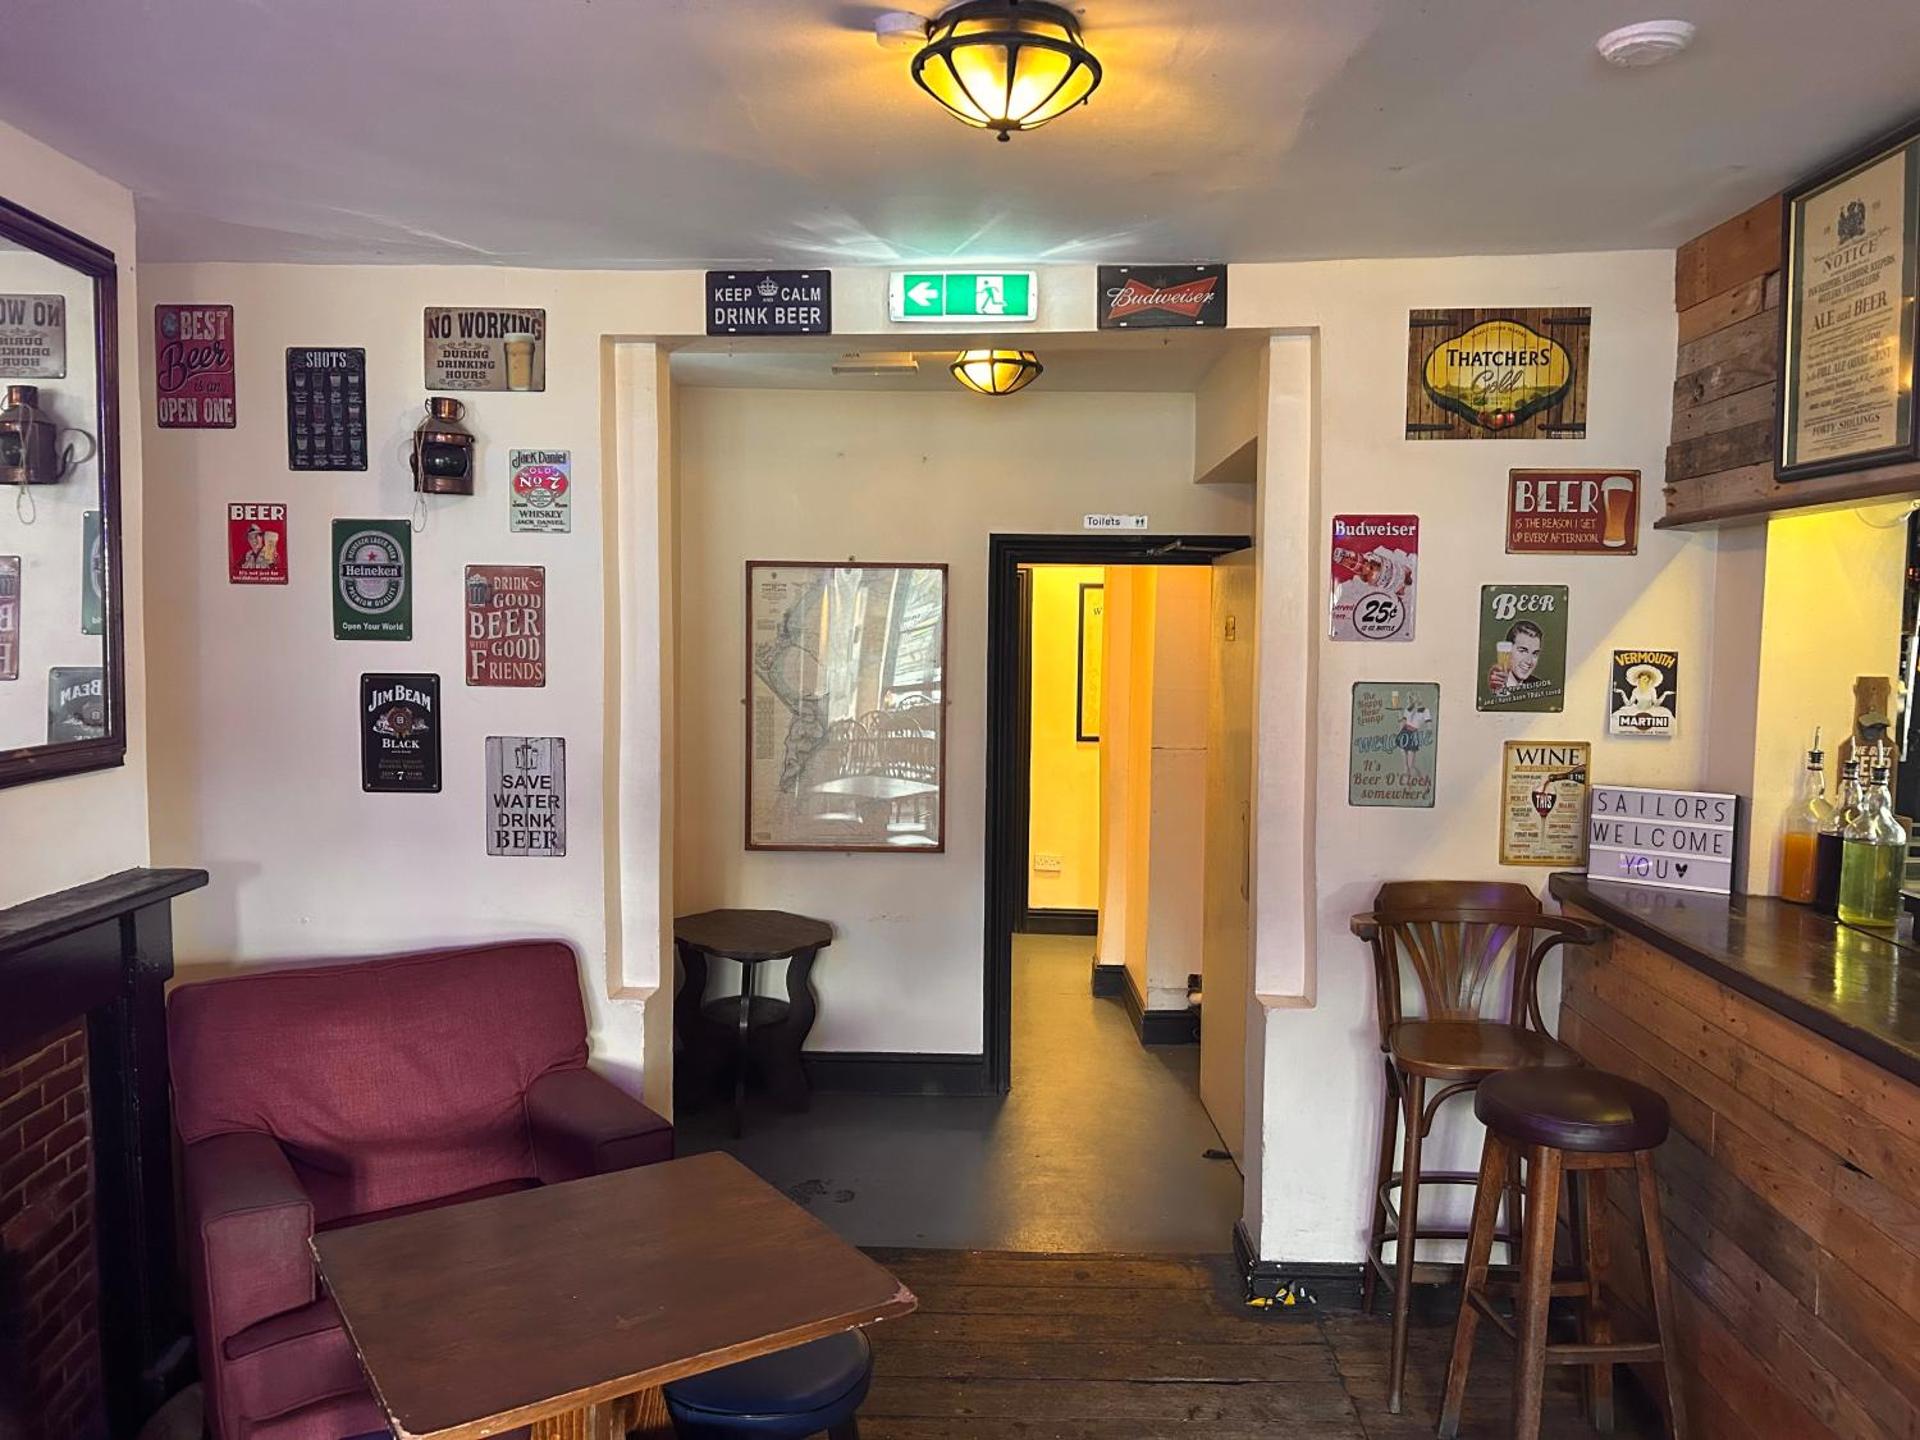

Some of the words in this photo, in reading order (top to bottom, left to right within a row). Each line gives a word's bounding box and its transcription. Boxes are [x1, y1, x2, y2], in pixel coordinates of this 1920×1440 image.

[1824, 240, 1877, 270] NOTICE
[714, 288, 752, 302] KEEP
[781, 288, 820, 301] CALM
[1106, 287, 1215, 308] Budweiser
[714, 307, 768, 324] DRINK
[775, 307, 821, 324] BEER
[1814, 309, 1834, 330] ALE
[1854, 290, 1888, 316] BEER
[180, 311, 228, 340] BEST
[428, 314, 452, 339] NO
[458, 312, 542, 341] WORKING
[306, 352, 347, 368] SHOTS
[443, 350, 489, 359] DURING
[1446, 348, 1550, 366] THATCHERS
[158, 341, 231, 393] Beer
[436, 360, 496, 369] DRINKING
[445, 370, 486, 380] HOURS
[1470, 370, 1525, 396] Gold
[160, 398, 198, 423] OPEN
[203, 398, 233, 423] ONE
[1812, 424, 1835, 436] FORTY
[1839, 413, 1880, 430] SHILLINGS
[512, 451, 537, 468] Jack
[538, 451, 566, 464] Daniel
[547, 476, 561, 490] 7
[1515, 480, 1598, 514] BEER
[231, 506, 284, 520] BEER
[519, 510, 564, 518] WHISKEY
[1088, 516, 1120, 526] Toilets
[1335, 520, 1416, 536] Budweiser
[1516, 519, 1522, 528] IS
[1526, 518, 1540, 528] THE
[1542, 518, 1573, 528] REASON
[1580, 518, 1596, 529] GET
[1512, 532, 1522, 543] UP
[1524, 532, 1550, 544] EVERY
[346, 564, 398, 576] Heineken
[493, 576, 530, 590] DRINK
[347, 580, 373, 607] PREMIUM
[374, 580, 398, 606] QUALITY
[493, 593, 542, 608] GOOD
[1362, 600, 1398, 624] 25¢
[1492, 594, 1555, 620] BEER
[342, 622, 362, 631] Open
[363, 622, 380, 630] Your
[382, 622, 404, 630] World
[468, 608, 541, 640] BEER
[469, 640, 488, 650] WITH
[491, 636, 540, 661] GOOD
[471, 650, 542, 680] FRIENDS
[1615, 652, 1676, 668] VERMOUTH
[368, 689, 394, 712] JIM
[394, 684, 431, 712] BEAM
[1620, 716, 1668, 726] MARTINI
[382, 738, 420, 748] BLACK
[1354, 730, 1433, 754] WELCOME
[1516, 748, 1580, 766] WINE
[1364, 760, 1381, 771] It's
[397, 771, 404, 780] 7
[502, 774, 552, 789] SAVE
[1353, 772, 1381, 785] Beer
[1386, 772, 1432, 788] O'Clock
[494, 794, 560, 808] WATER
[1361, 787, 1430, 800] somewhere
[1536, 794, 1552, 809] THIS
[1598, 792, 1727, 822] SAILORS
[498, 814, 556, 828] DRINK
[495, 830, 560, 850] BEER
[1593, 822, 1723, 854] WELCOME
[1625, 856, 1668, 879] YOU
